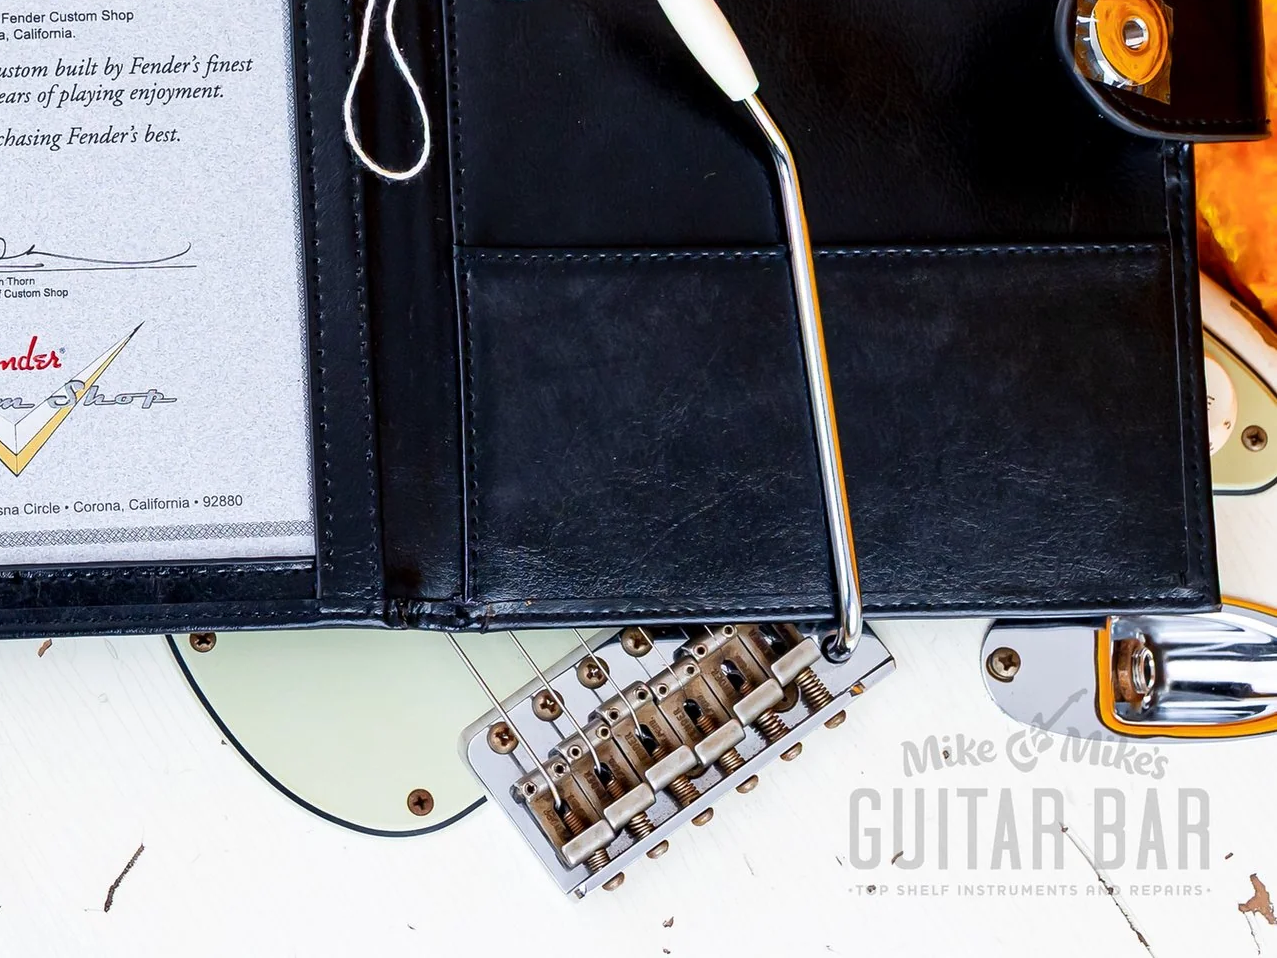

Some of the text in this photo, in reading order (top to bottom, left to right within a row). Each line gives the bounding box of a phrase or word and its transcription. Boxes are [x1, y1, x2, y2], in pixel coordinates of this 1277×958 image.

[2, 12, 46, 24] Fender
[50, 11, 97, 22] Custom
[101, 10, 134, 23] Shop
[14, 27, 75, 40] California.
[55, 57, 98, 77] built
[104, 57, 123, 81] by
[205, 54, 253, 81] finest
[37, 85, 60, 108] of
[59, 84, 125, 108] playing
[130, 83, 223, 106] enjoyment.
[145, 124, 180, 143] best.
[5, 277, 35, 285] Thorn
[4, 289, 41, 299] Custom
[43, 288, 68, 298] Shop
[48, 380, 177, 411] Shop
[24, 502, 60, 514] Circle
[74, 501, 124, 513] Corona,
[129, 497, 190, 510] California
[203, 495, 242, 507] 92880
